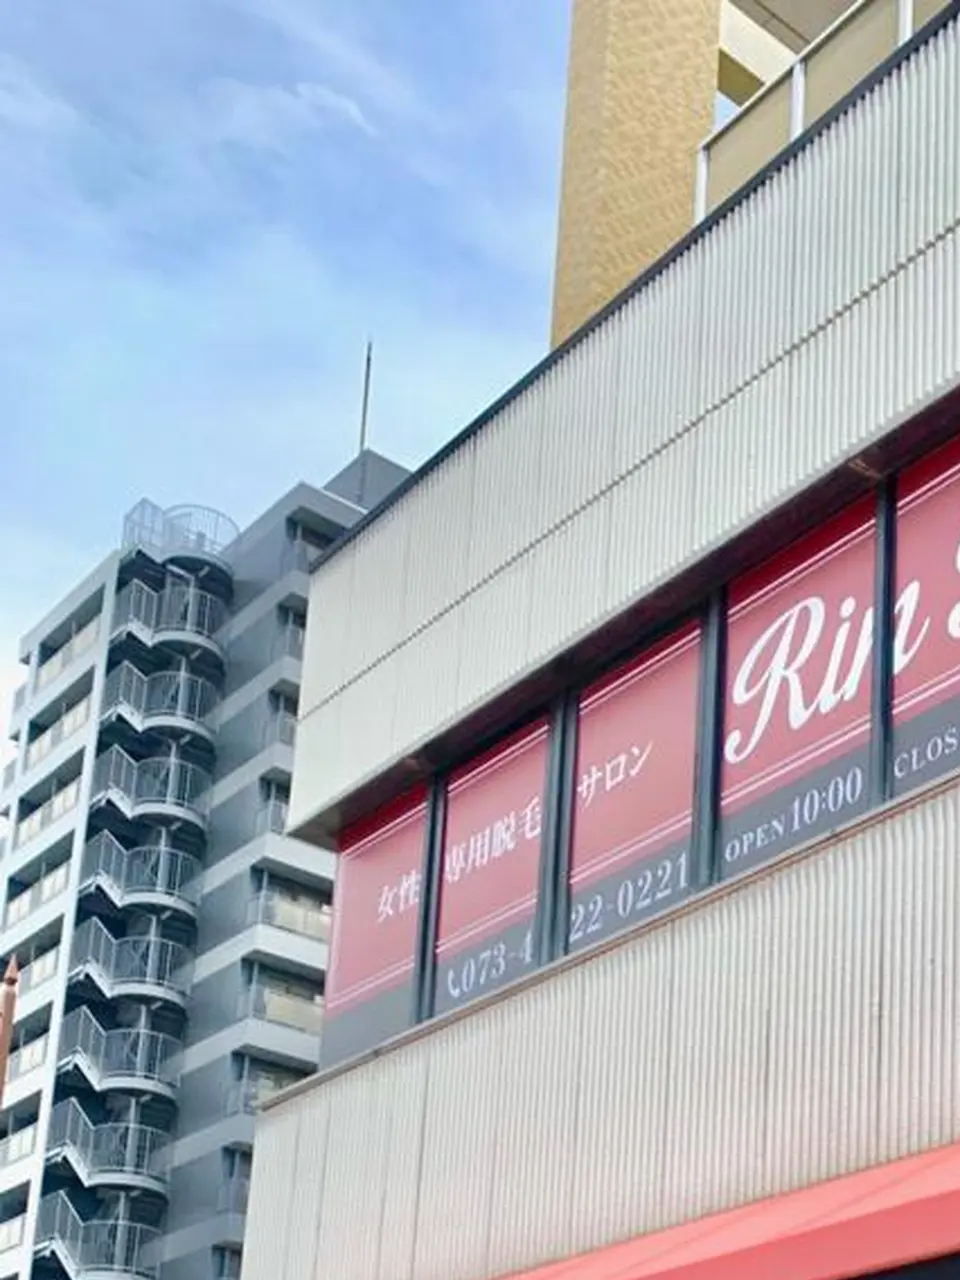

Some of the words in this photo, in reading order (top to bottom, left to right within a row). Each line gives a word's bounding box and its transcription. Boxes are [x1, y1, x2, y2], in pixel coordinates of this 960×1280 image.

[726, 578, 930, 763] Rin
[724, 819, 785, 862] OPEN
[791, 768, 863, 833] 10:00
